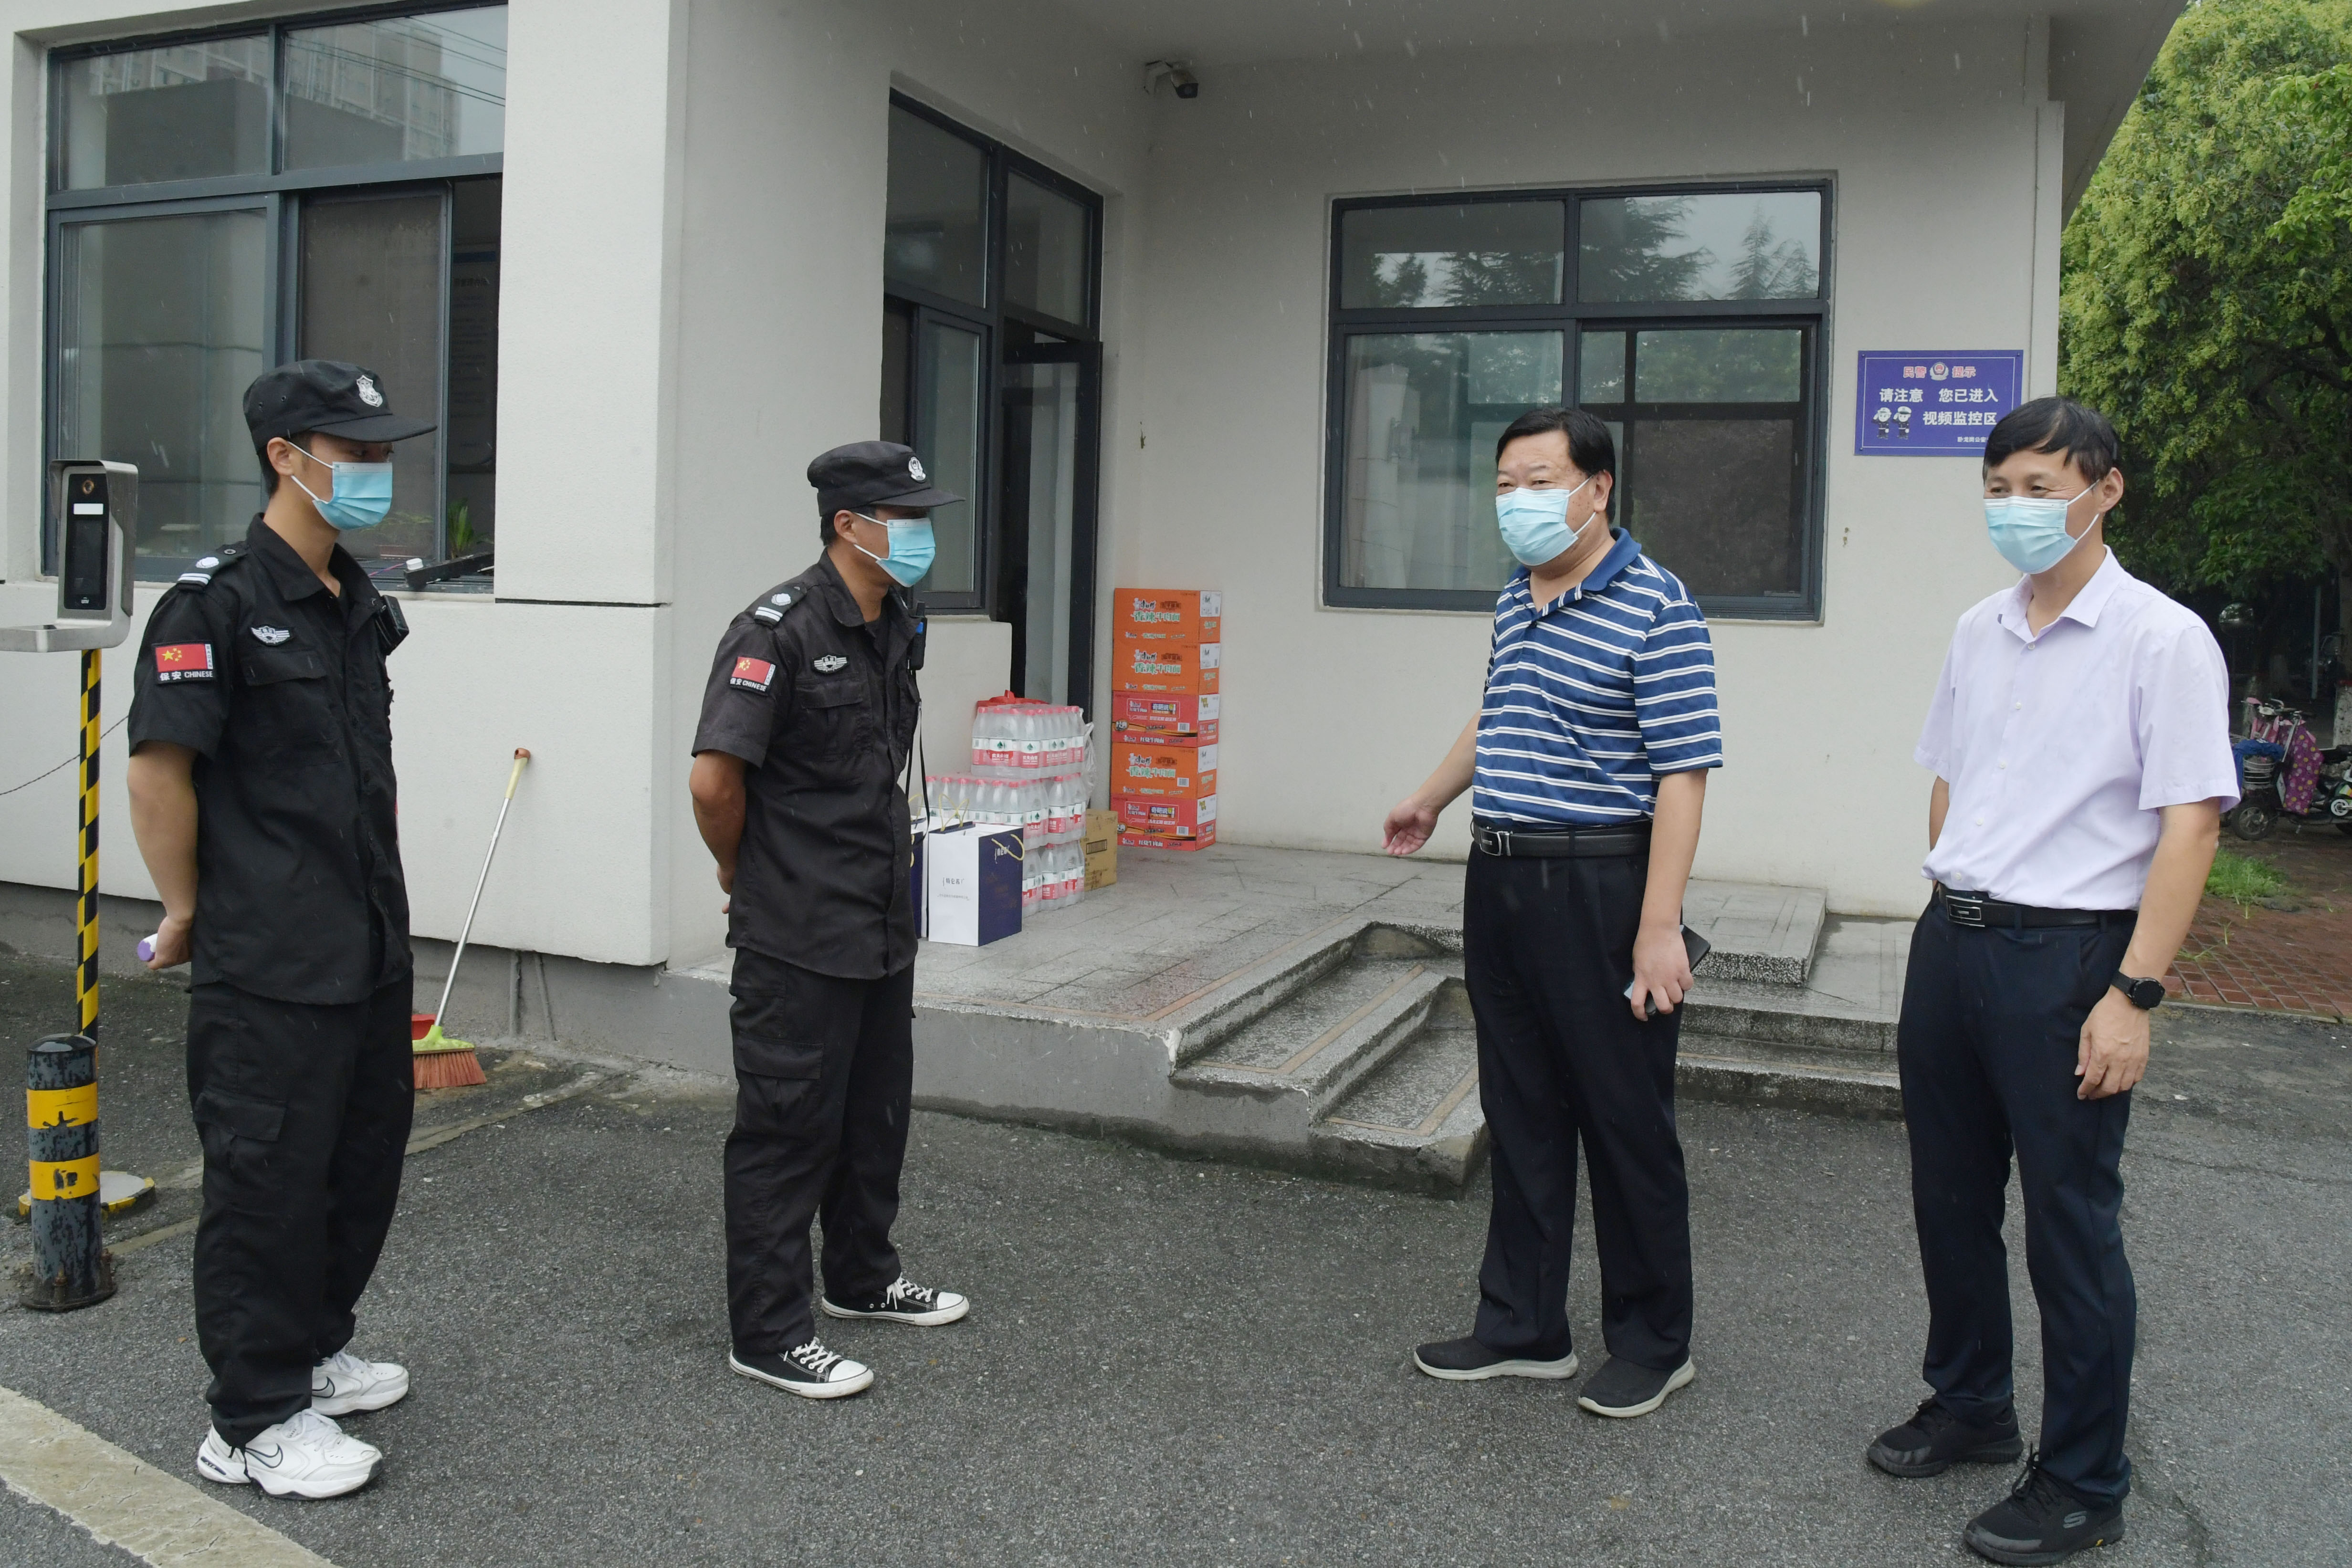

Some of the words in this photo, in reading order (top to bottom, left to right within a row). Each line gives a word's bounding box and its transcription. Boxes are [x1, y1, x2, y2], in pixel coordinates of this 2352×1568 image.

[1903, 366, 1927, 378] 民警
[1952, 366, 1976, 378] 提示
[1880, 388, 1923, 402] 请注意
[1939, 388, 1998, 402] 您已进入
[1922, 411, 1997, 425] 视频监控区
[1130, 611, 1180, 623] 香辣牛肉面
[1131, 662, 1181, 675] 香辣牛肉面
[160, 671, 182, 681] 保安
[742, 680, 767, 692] CHINESE
[1126, 765, 1176, 778] 香辣牛肉面
